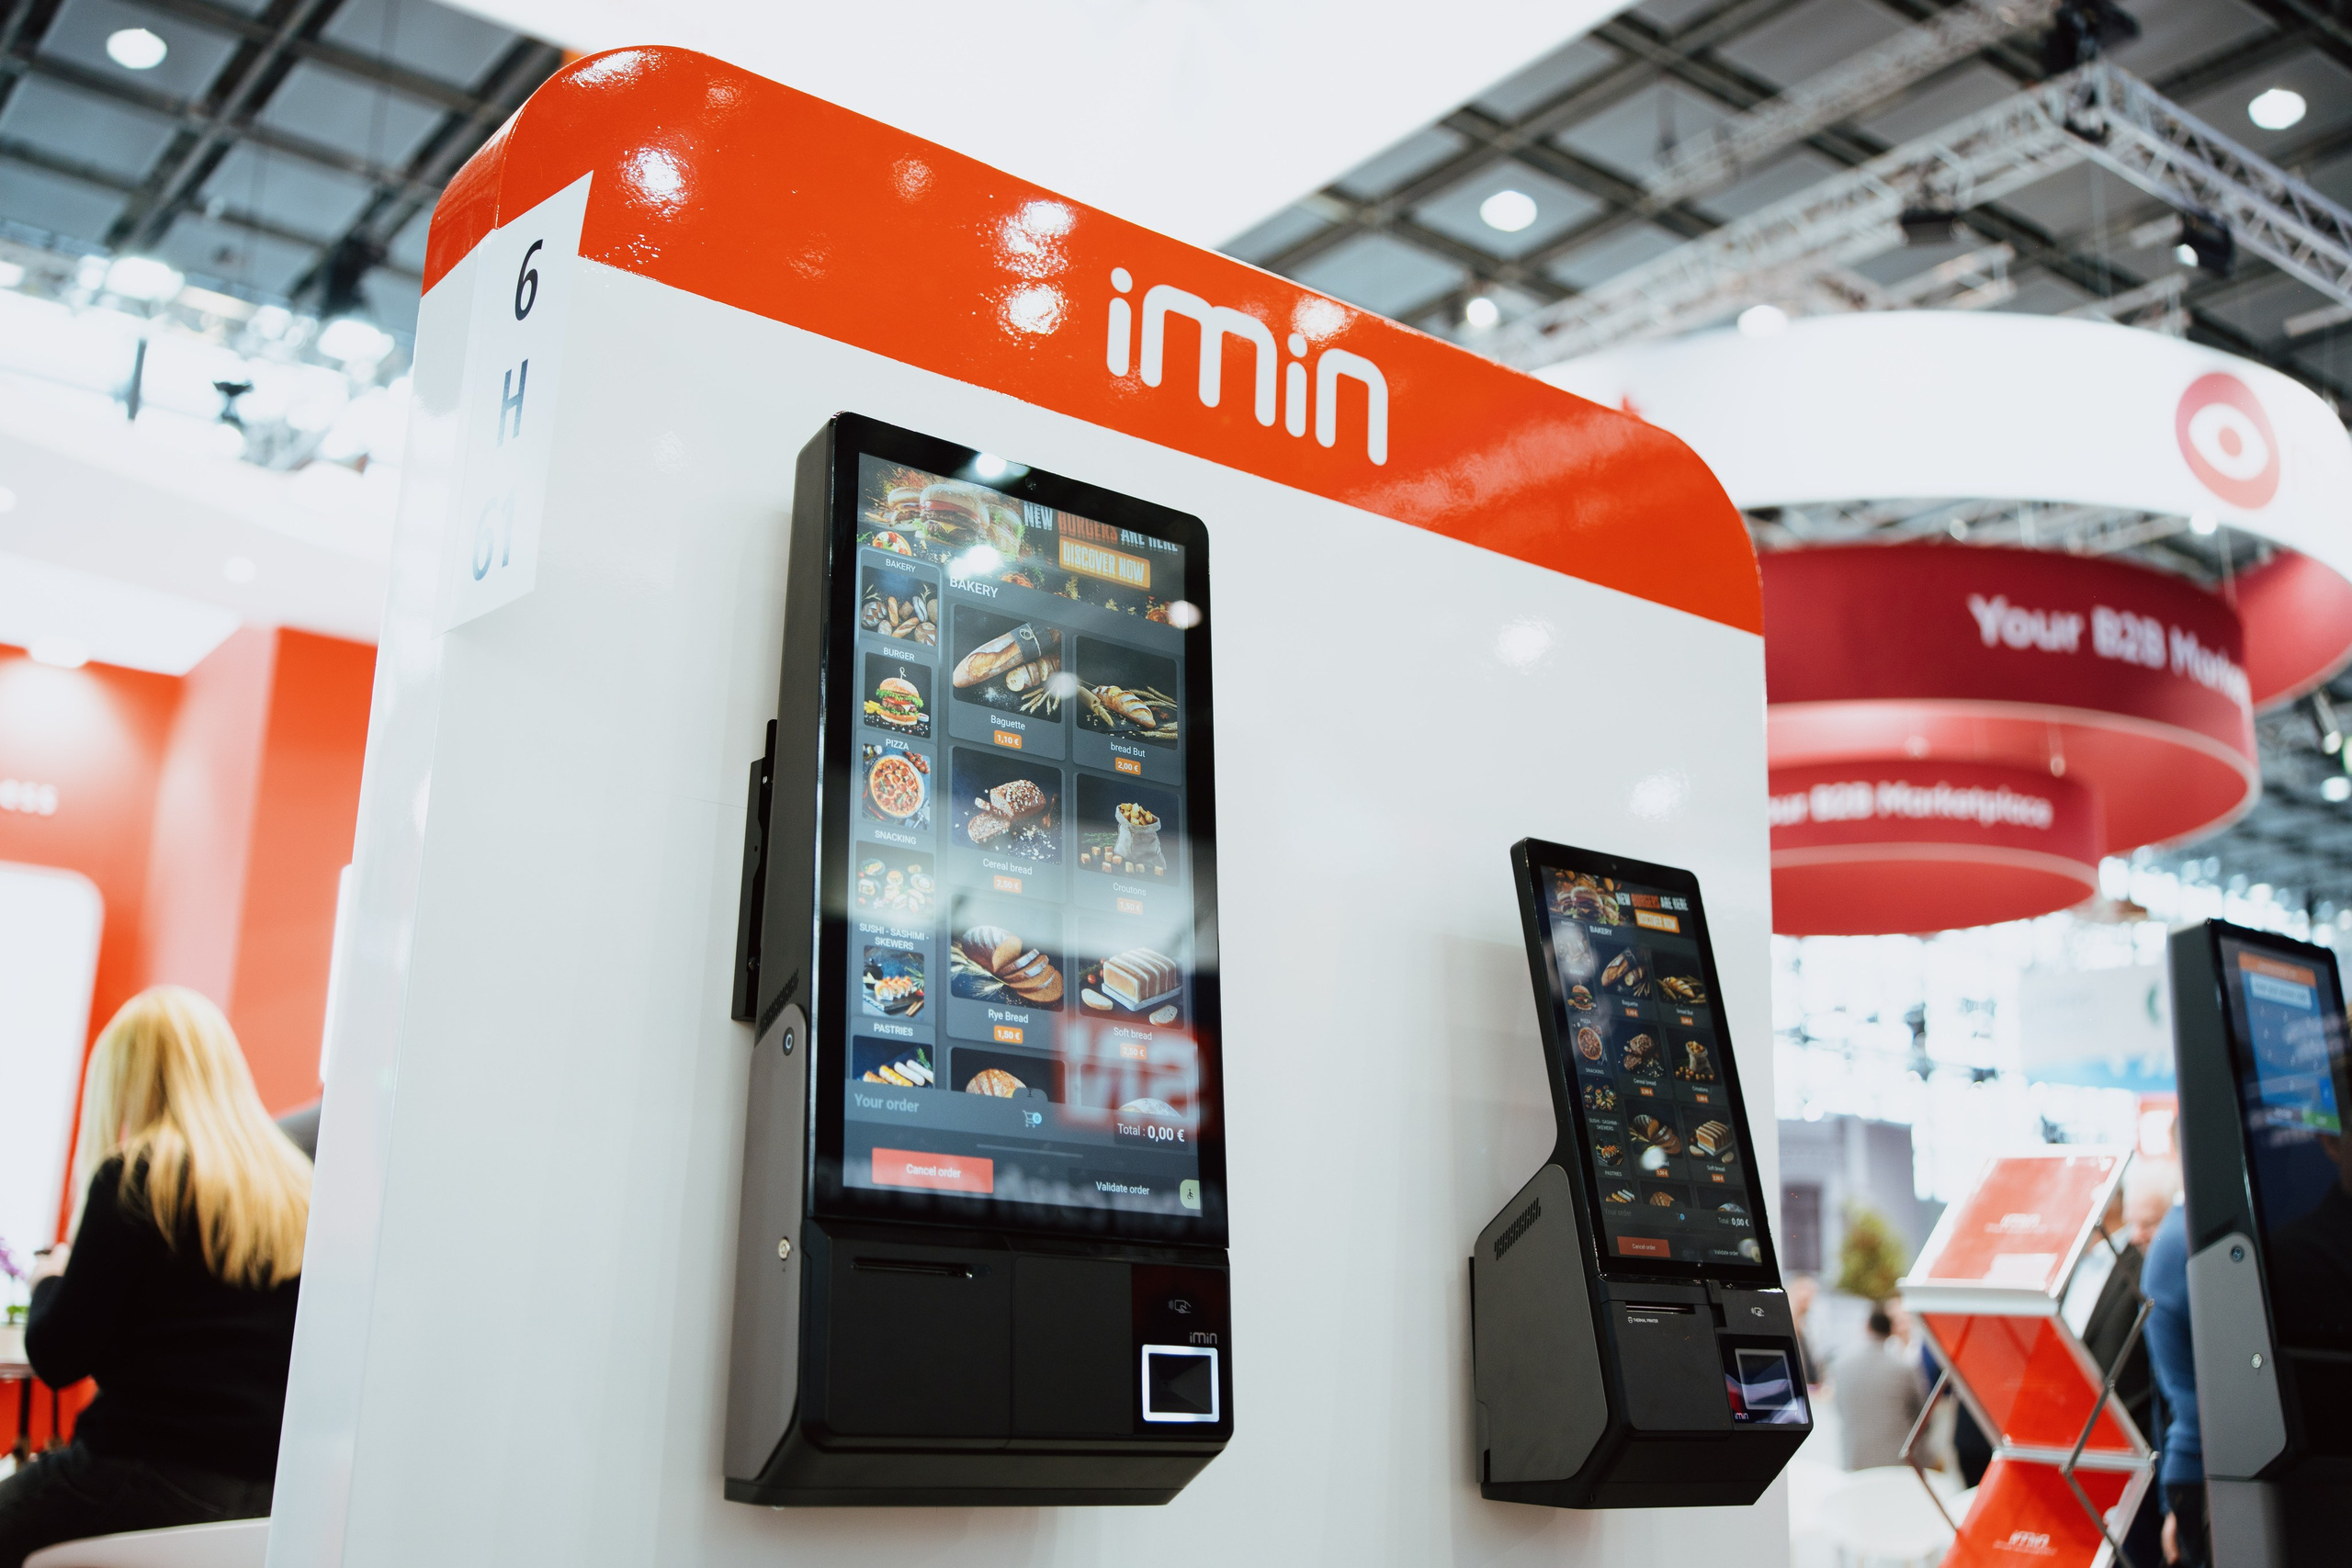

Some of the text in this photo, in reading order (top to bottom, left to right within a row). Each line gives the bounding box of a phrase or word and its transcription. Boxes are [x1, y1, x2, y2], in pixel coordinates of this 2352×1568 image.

[514, 239, 544, 321] 6
[1106, 266, 1389, 467] imin
[496, 358, 529, 448] H
[1024, 501, 1053, 531] NEW
[1058, 512, 1118, 544] BURGERS
[472, 487, 516, 581] 61
[886, 558, 916, 572] BAKERY
[1063, 541, 1145, 582] DISCOVER NOW
[949, 577, 998, 598] BAKERY
[1968, 593, 2084, 654] Your
[2091, 604, 2167, 670] B2B
[884, 647, 915, 661] BURGER
[990, 714, 1025, 731] Baguette
[885, 738, 910, 750] PIZZA
[997, 734, 1012, 746] 1,10
[1110, 741, 1146, 758] bread But
[1117, 761, 1132, 772] 2,00
[875, 829, 917, 845] SNACKING
[982, 857, 1033, 875] Cereal bread
[1113, 882, 1147, 897] Croutons
[859, 923, 885, 937] SUSHI
[890, 928, 923, 942] SASHIMI
[1589, 925, 1612, 936] BAKERY
[875, 936, 914, 951] SKEWERS
[988, 1009, 1029, 1024] Rye Bread
[873, 1022, 913, 1037] PASTRIES
[997, 1029, 1013, 1041] 1,50
[1114, 1027, 1152, 1042] Soft bread
[1122, 1046, 1137, 1057] 2,50
[854, 1093, 919, 1114] Your order
[1117, 1122, 1141, 1136] Total
[1148, 1124, 1173, 1144] 0,00
[1177, 1128, 1185, 1143] €
[906, 1163, 961, 1179] Cancel order
[1096, 1181, 1150, 1197] Validate order
[1731, 1217, 1745, 1226] 0,00
[1189, 1331, 1218, 1345] imin
